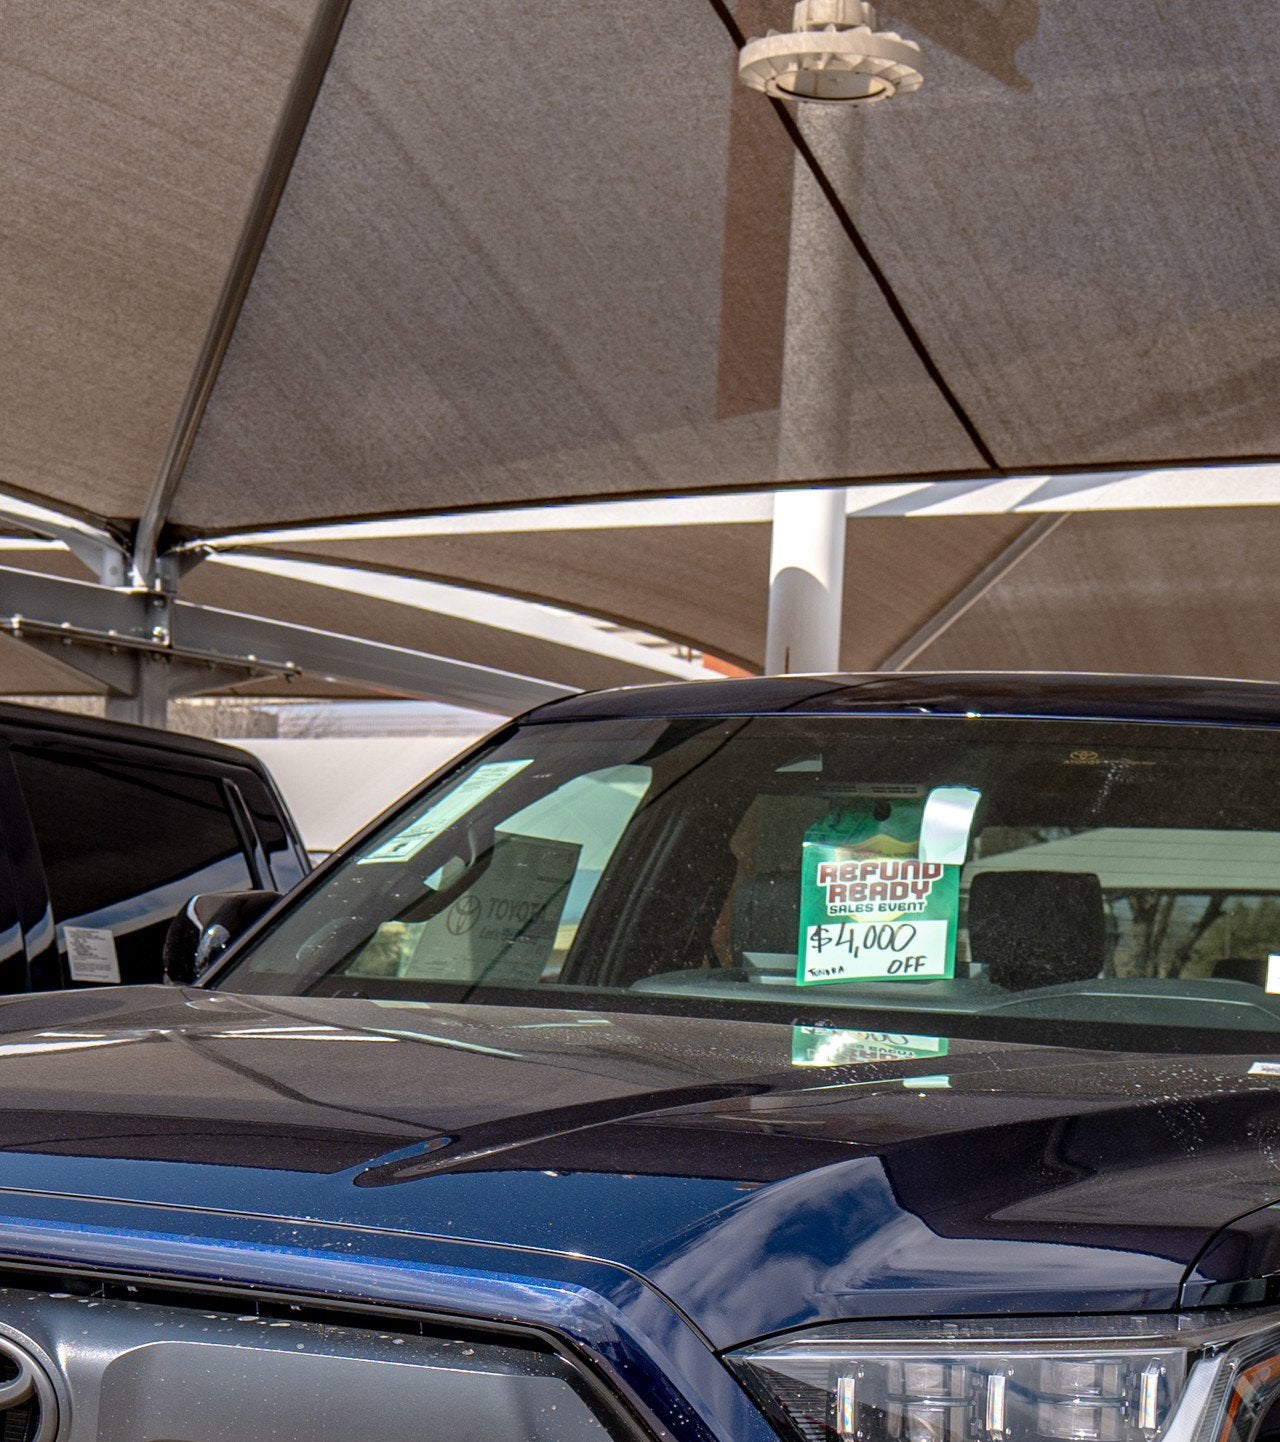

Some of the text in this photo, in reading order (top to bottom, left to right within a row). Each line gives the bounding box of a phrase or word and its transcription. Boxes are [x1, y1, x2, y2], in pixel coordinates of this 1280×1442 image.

[818, 860, 942, 884] REFUND
[827, 880, 932, 904] READY
[486, 896, 548, 922] TOYOT
[829, 901, 926, 914] SALES EVENT
[810, 922, 917, 958] $4,000
[886, 955, 926, 975] OFF
